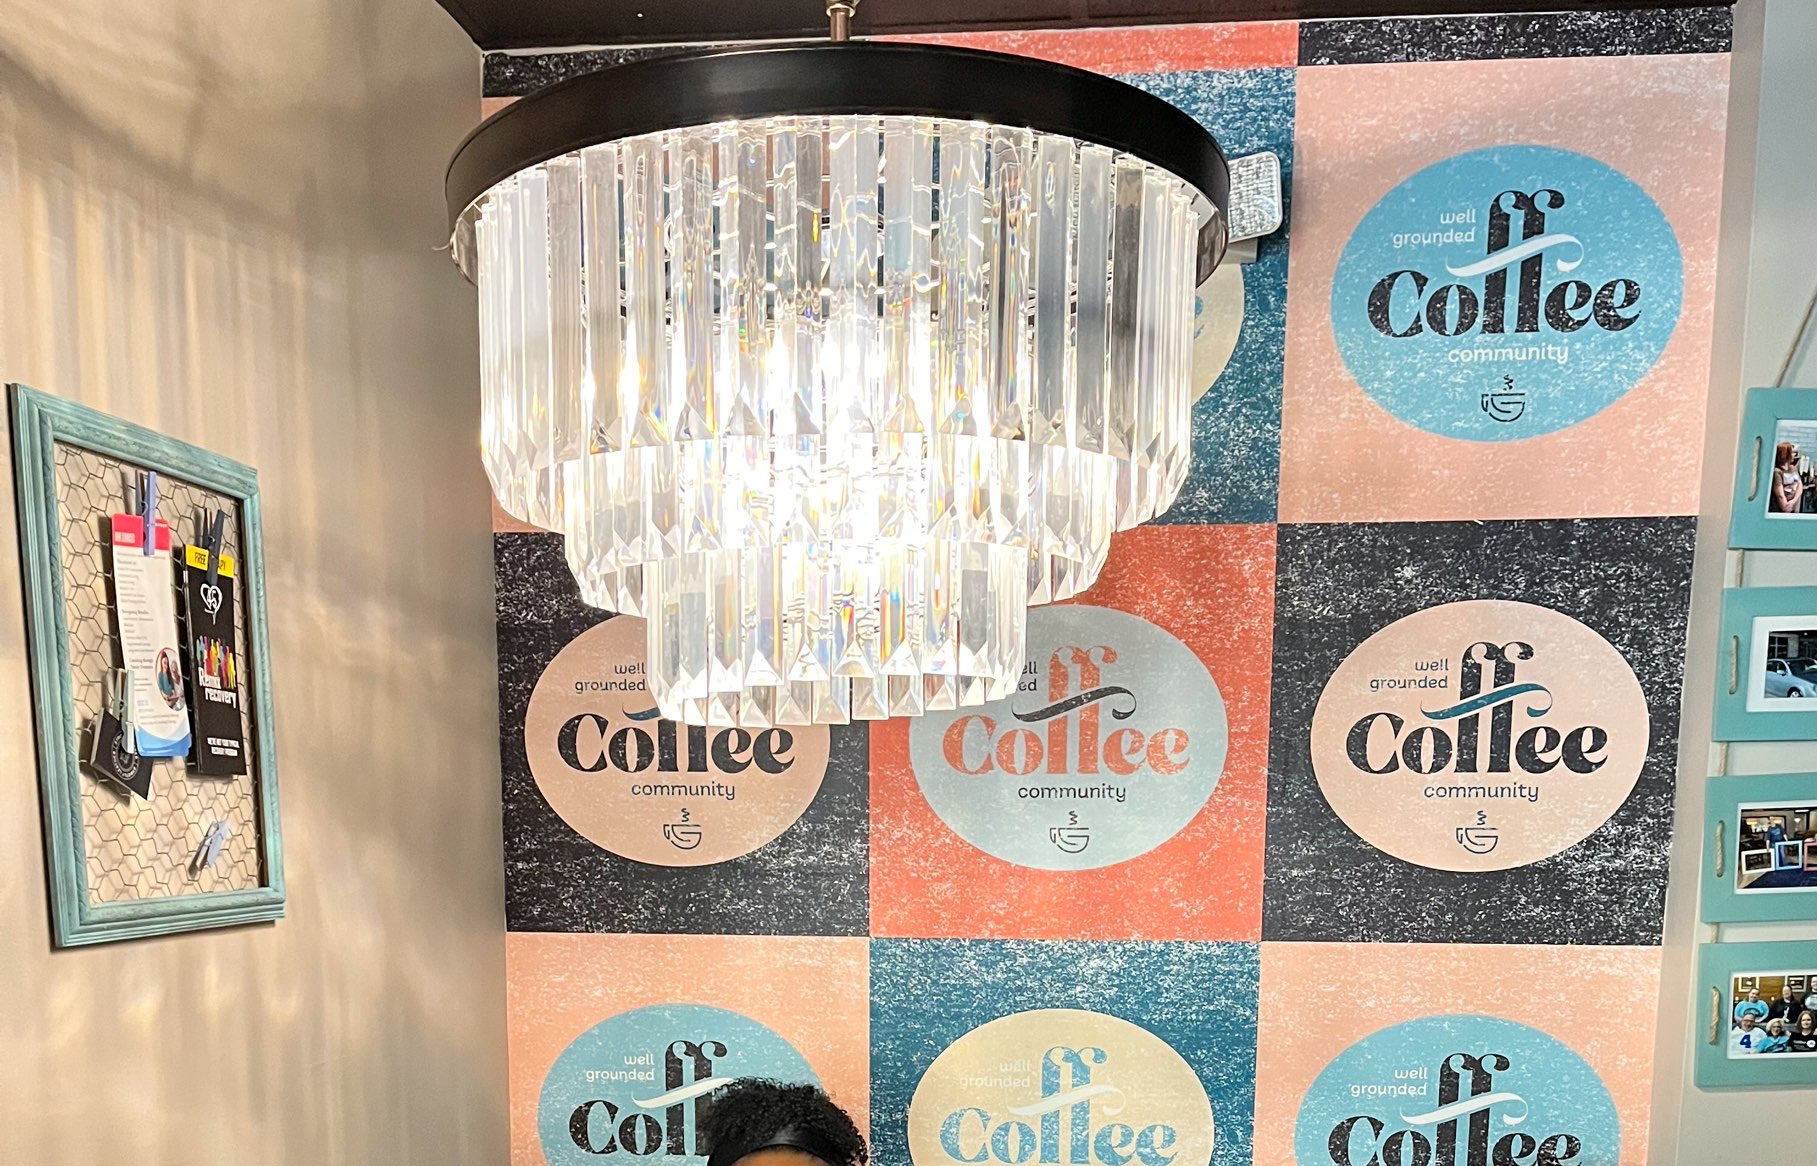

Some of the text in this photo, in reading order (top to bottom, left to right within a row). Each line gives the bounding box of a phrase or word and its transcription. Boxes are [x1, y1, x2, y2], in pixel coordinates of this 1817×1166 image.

[1440, 208, 1477, 225] well
[1392, 227, 1476, 249] grounded
[1367, 189, 1642, 338] Coffee
[1448, 343, 1569, 364] community
[614, 662, 646, 675] well
[1020, 660, 1038, 675] ell
[1415, 658, 1449, 673] well
[574, 679, 647, 694] grounded
[1370, 675, 1449, 693] grounded
[942, 645, 1191, 777] Coffee
[1345, 641, 1609, 775] Coffee
[631, 780, 736, 801] community
[1017, 784, 1127, 803] community
[1423, 783, 1540, 803] community
[1739, 1034, 1752, 1049] 4
[623, 1053, 655, 1067] well
[999, 1061, 1031, 1072] well
[585, 1068, 655, 1084] grounded
[1394, 1067, 1428, 1080] well
[959, 1076, 1031, 1090] grounded
[1350, 1083, 1428, 1098] grounded
[568, 1040, 728, 1156] Coff
